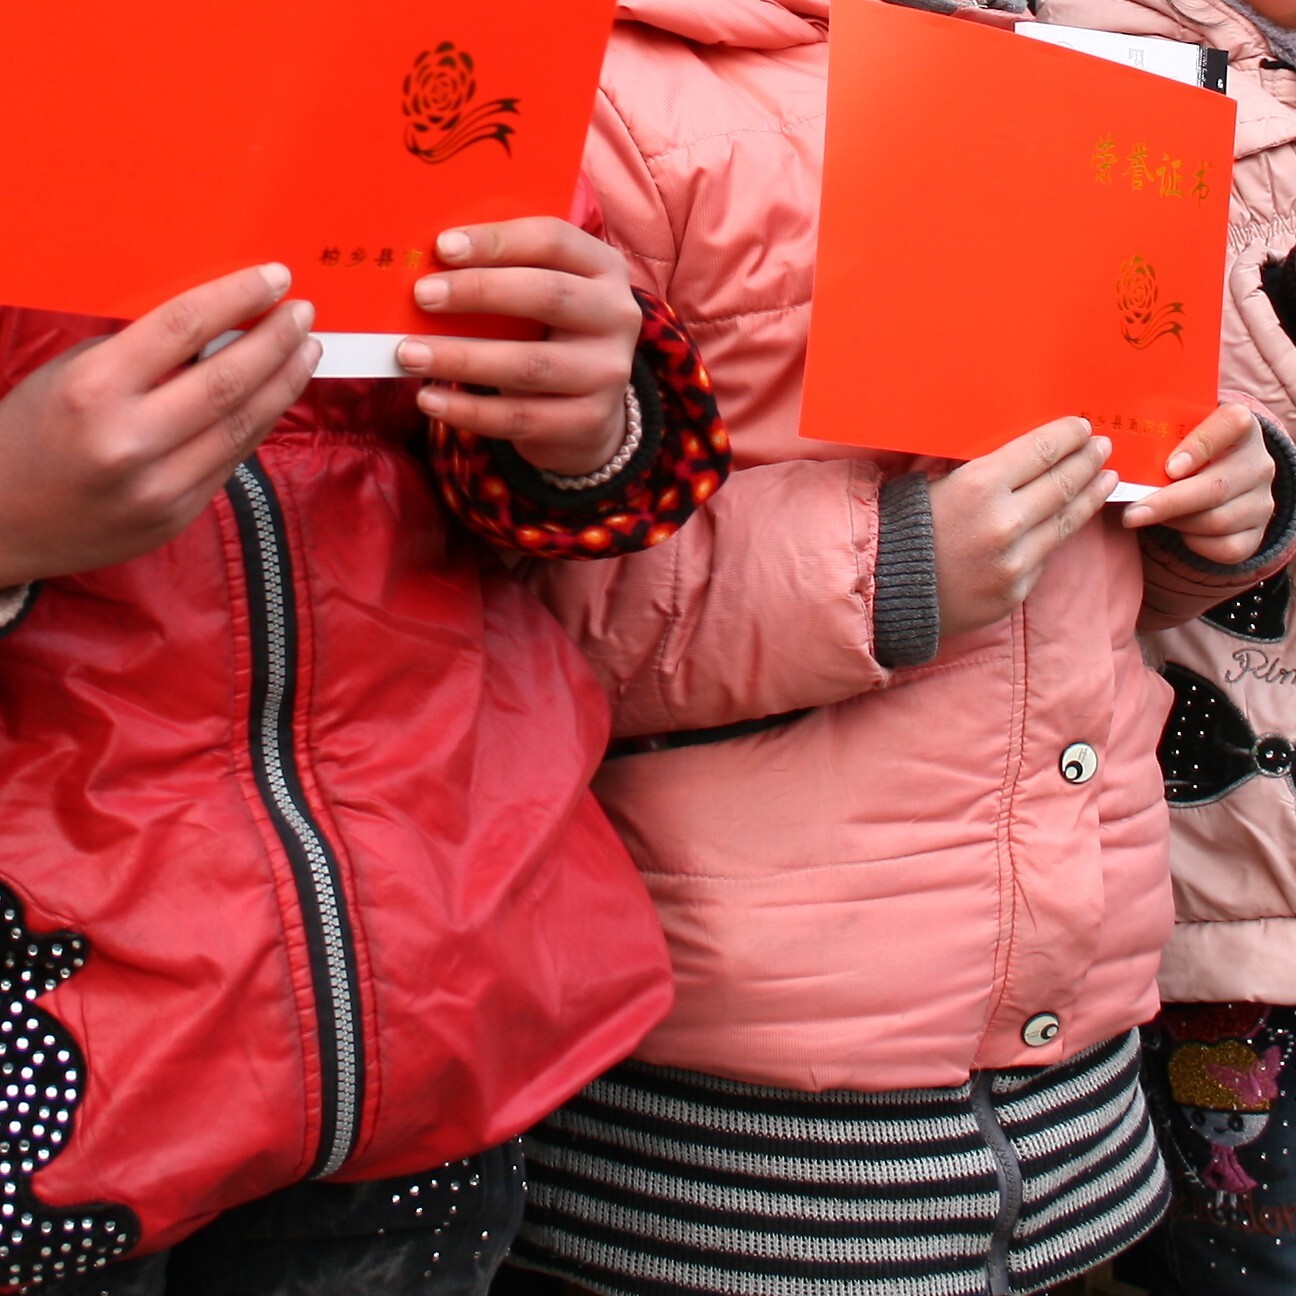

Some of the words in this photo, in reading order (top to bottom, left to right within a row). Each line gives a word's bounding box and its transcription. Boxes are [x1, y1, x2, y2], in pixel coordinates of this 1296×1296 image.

[1091, 131, 1213, 208] 荣誉证书
[318, 246, 426, 271] 柏乡县南
